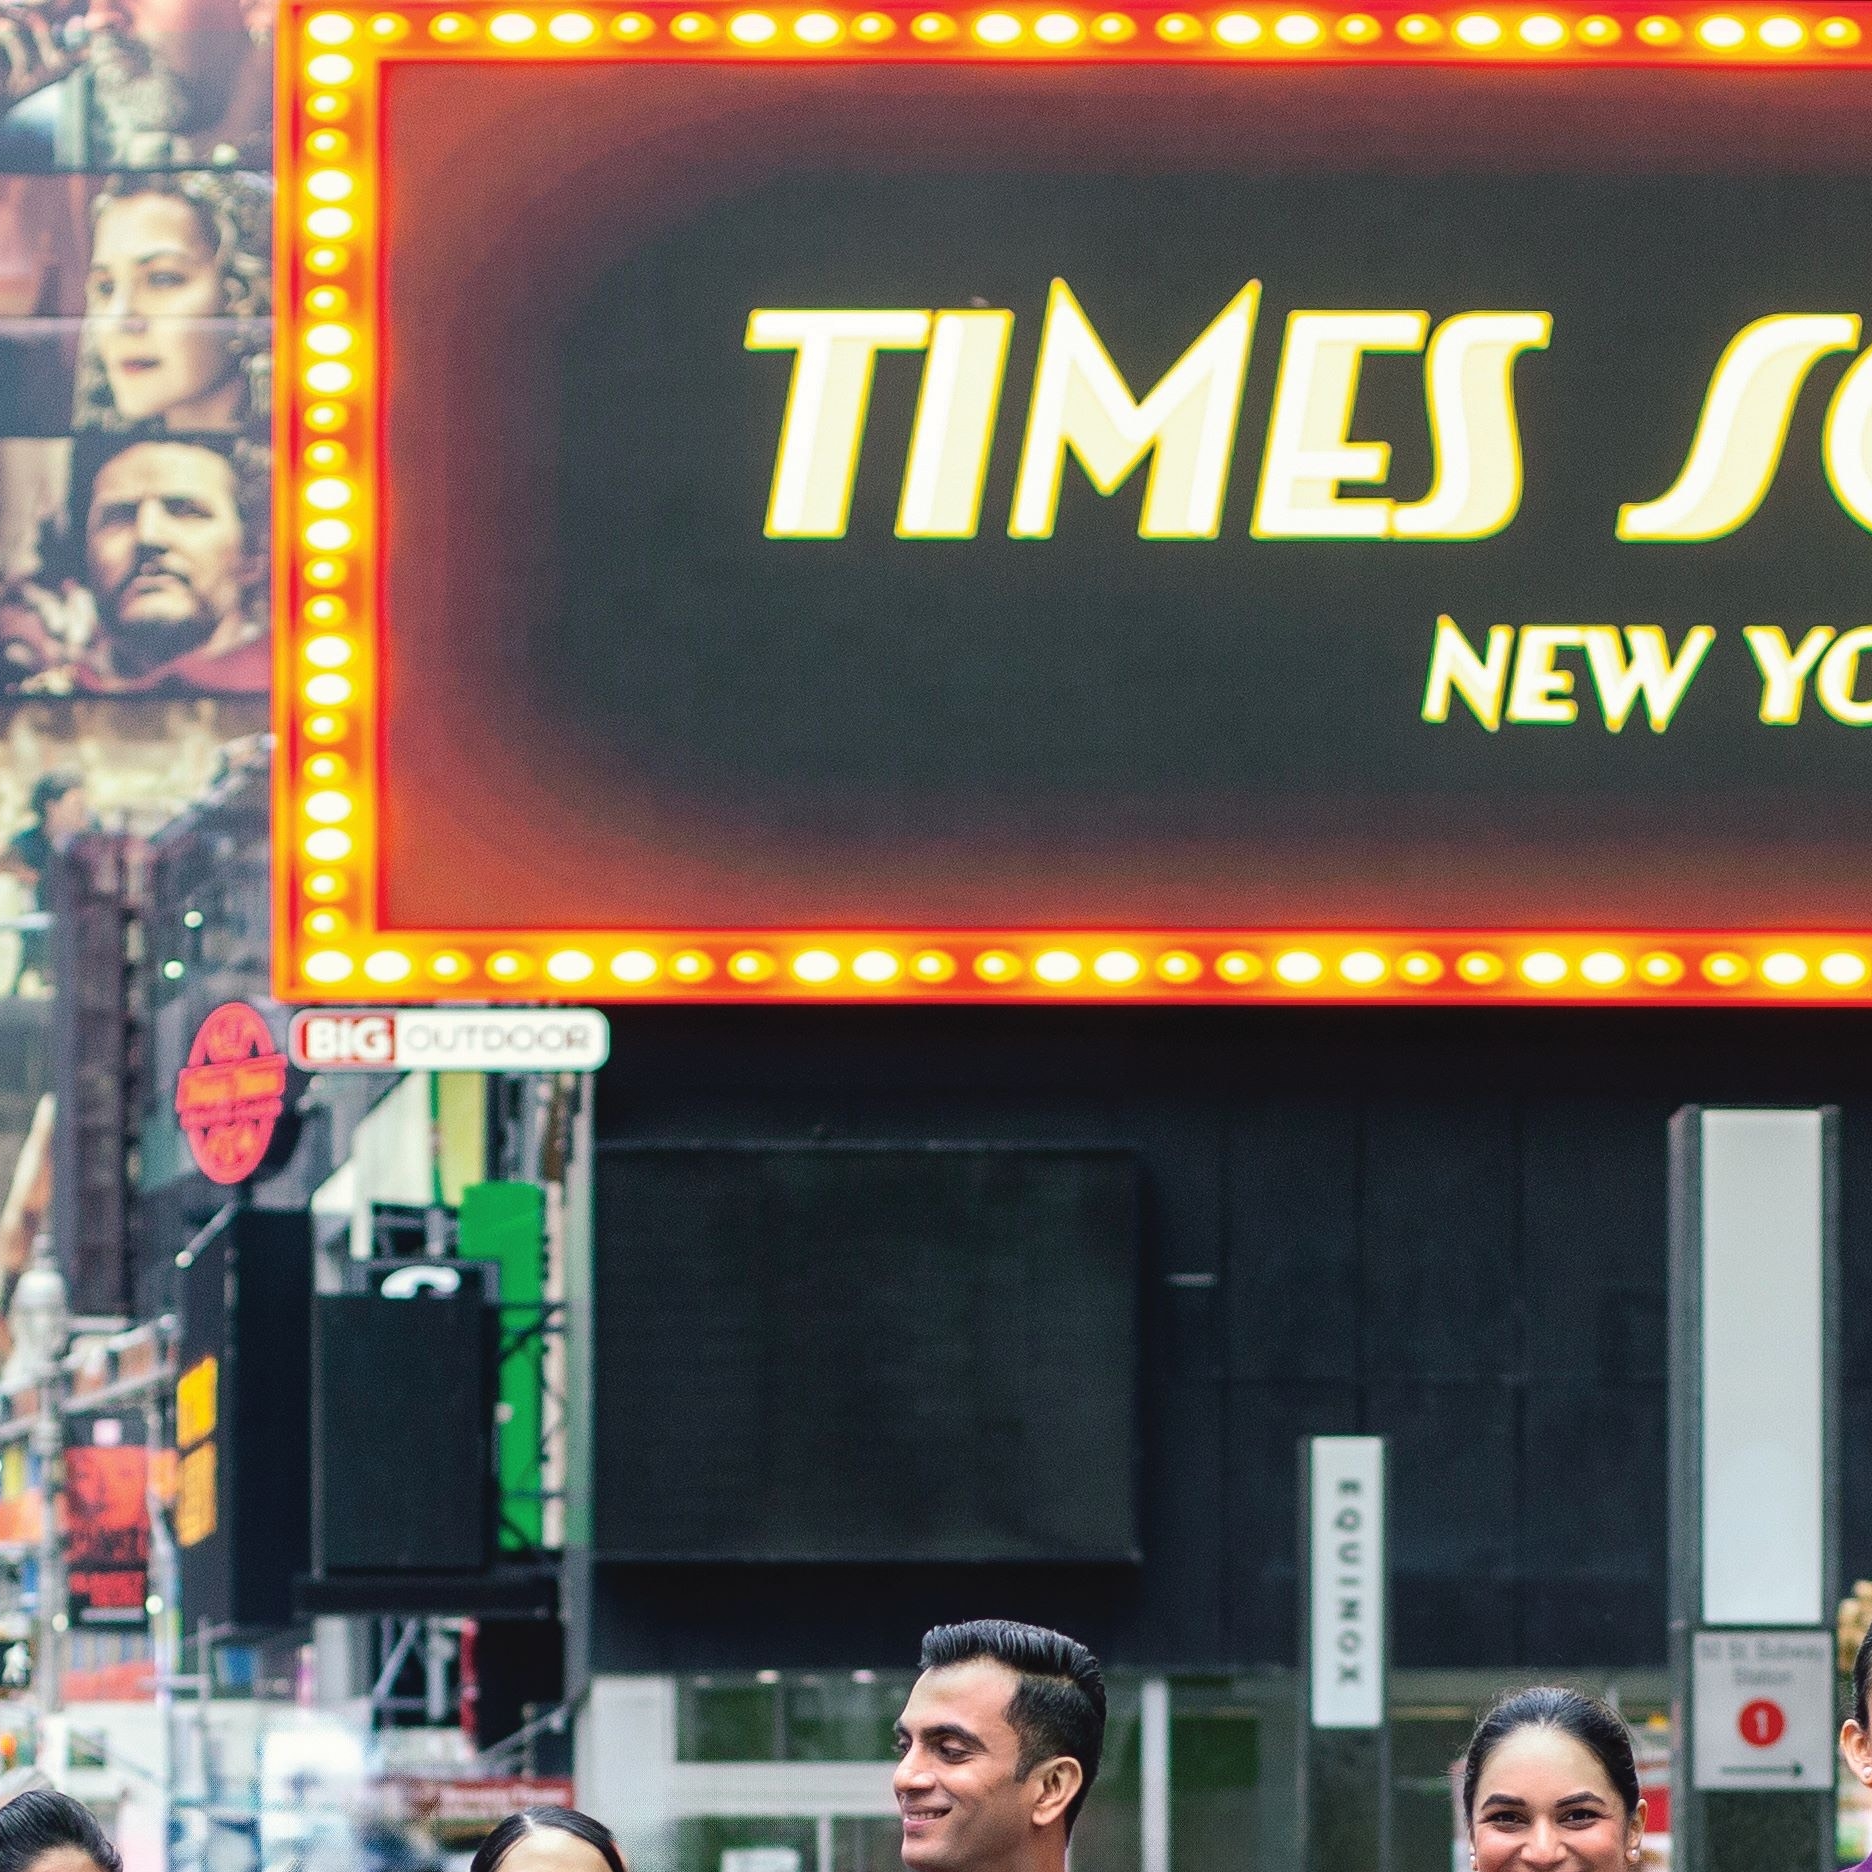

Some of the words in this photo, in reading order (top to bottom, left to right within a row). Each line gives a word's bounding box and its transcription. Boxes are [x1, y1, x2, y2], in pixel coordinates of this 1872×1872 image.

[745, 279, 1550, 539] TIMES
[1423, 619, 1713, 731] NEW
[306, 1016, 393, 1059] BIG
[405, 1022, 594, 1053] OUTDOOR
[1334, 1479, 1362, 1684] EQUINOX
[1754, 1708, 1770, 1740] 1
